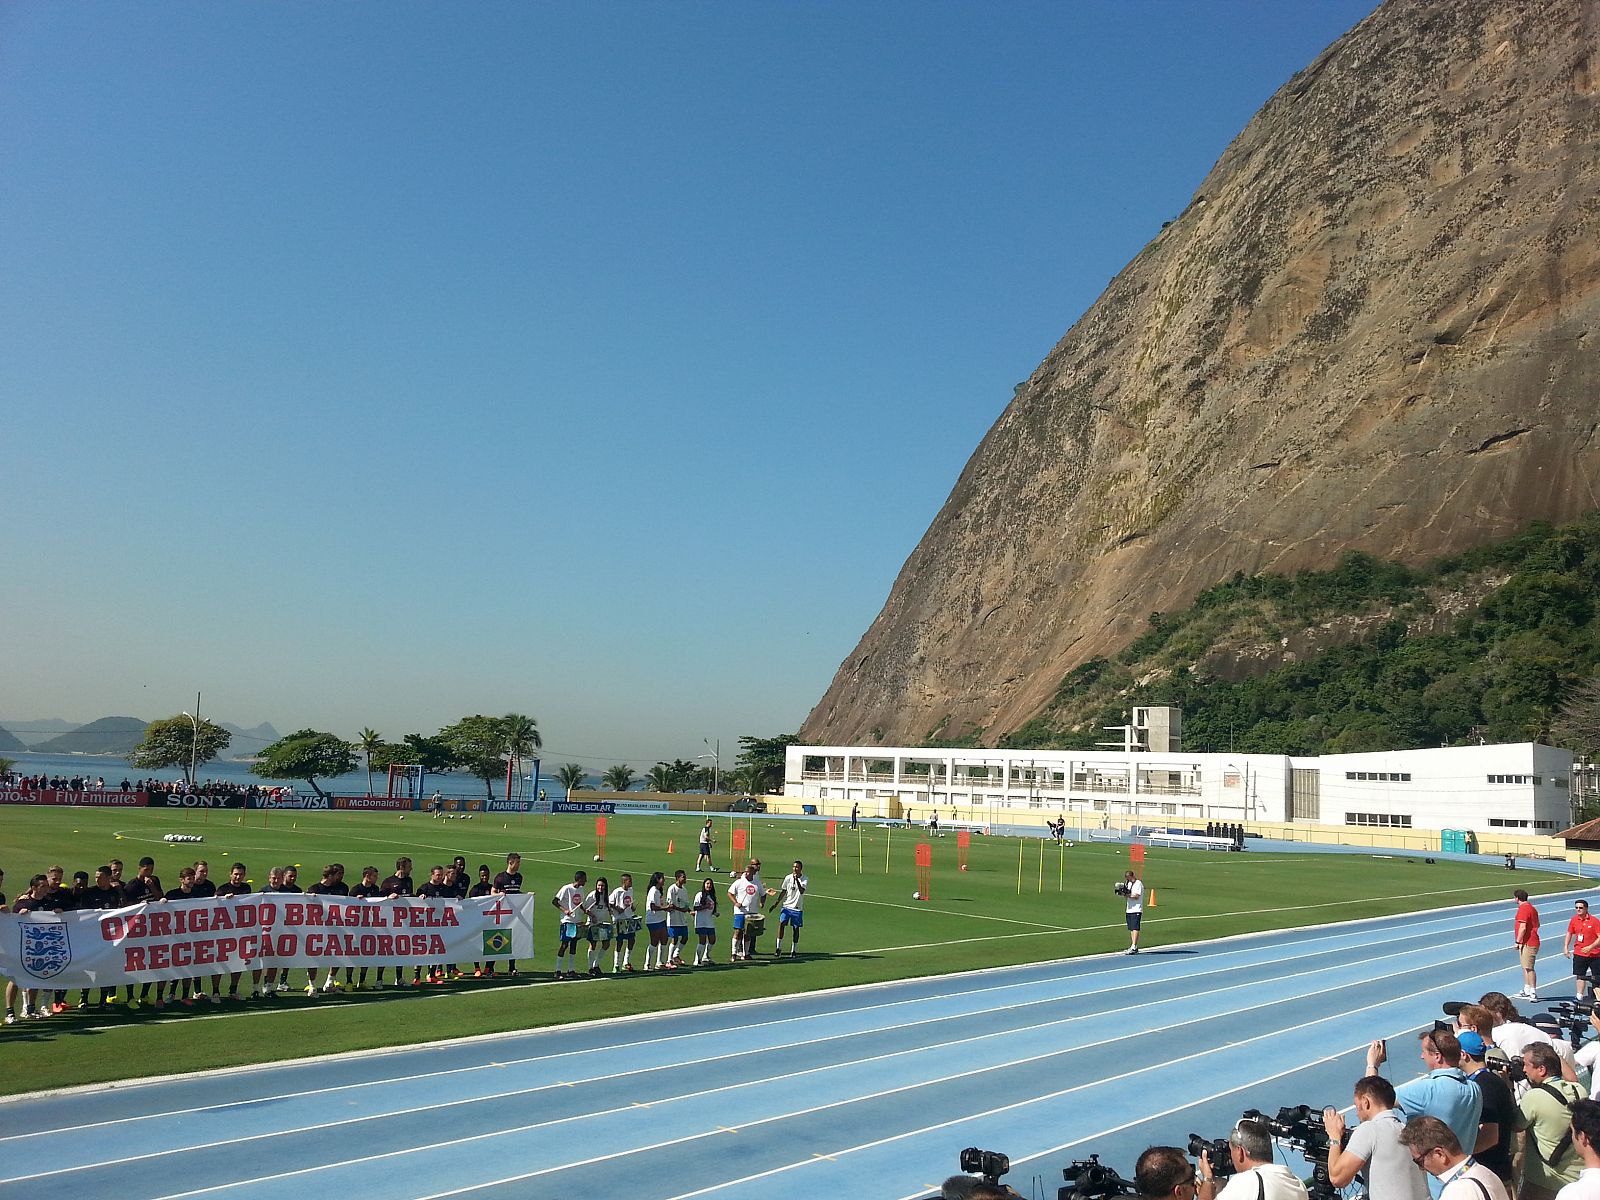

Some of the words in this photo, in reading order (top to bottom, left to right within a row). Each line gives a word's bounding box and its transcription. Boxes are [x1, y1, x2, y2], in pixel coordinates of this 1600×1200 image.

[55, 791, 79, 805] Fly
[81, 791, 137, 804] Emirates
[167, 794, 231, 807] SONY
[300, 796, 329, 809] VISA
[348, 798, 400, 808] McDonald's
[492, 801, 528, 811] MARFRIG
[585, 804, 611, 812] SOLAR
[101, 903, 276, 941] OBRIGADO
[284, 903, 387, 929] BRASIL
[393, 905, 459, 929] PELA
[124, 926, 298, 972] RECEPÇÃO
[306, 934, 447, 958] CALOROSA
